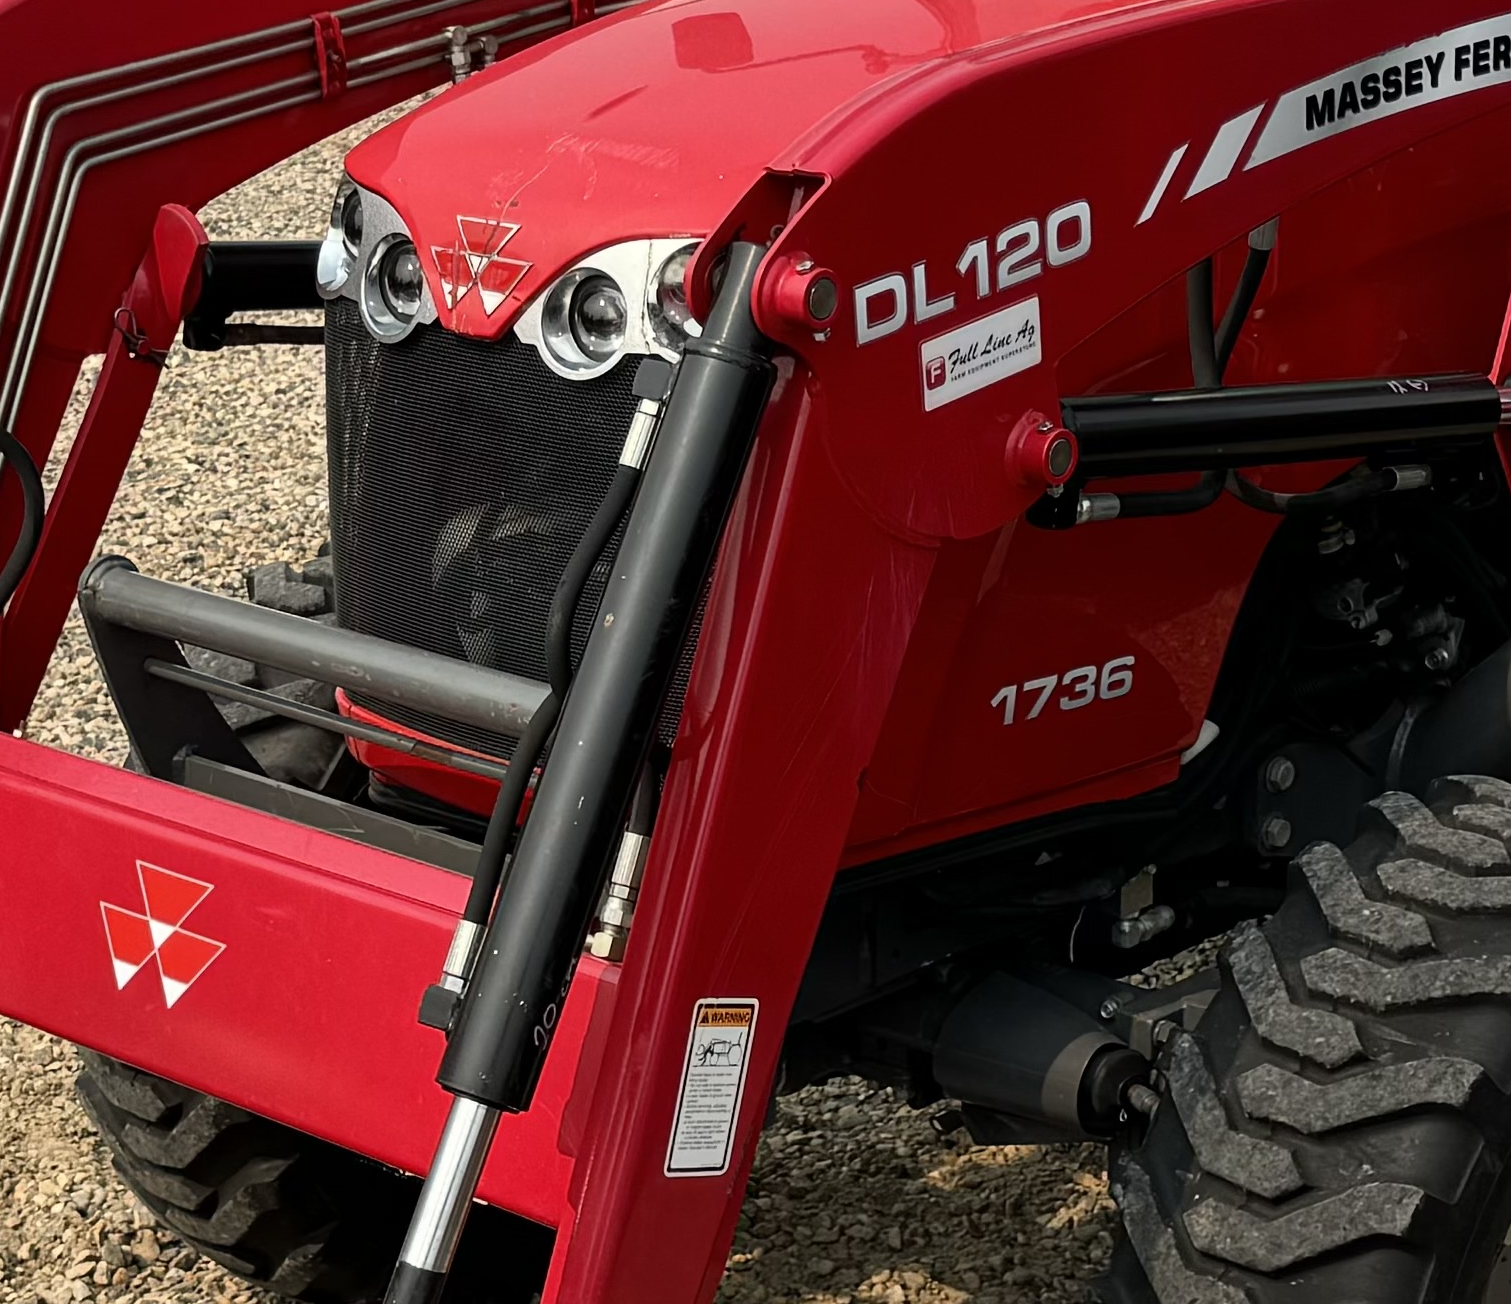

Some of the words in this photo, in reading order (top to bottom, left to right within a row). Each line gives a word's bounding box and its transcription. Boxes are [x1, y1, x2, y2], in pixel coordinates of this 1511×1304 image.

[1305, 51, 1445, 131] MASSEY
[948, 341, 978, 374] Full
[980, 333, 1012, 357] Line
[990, 655, 1136, 726] 1736
[711, 1011, 750, 1024] WARNING
